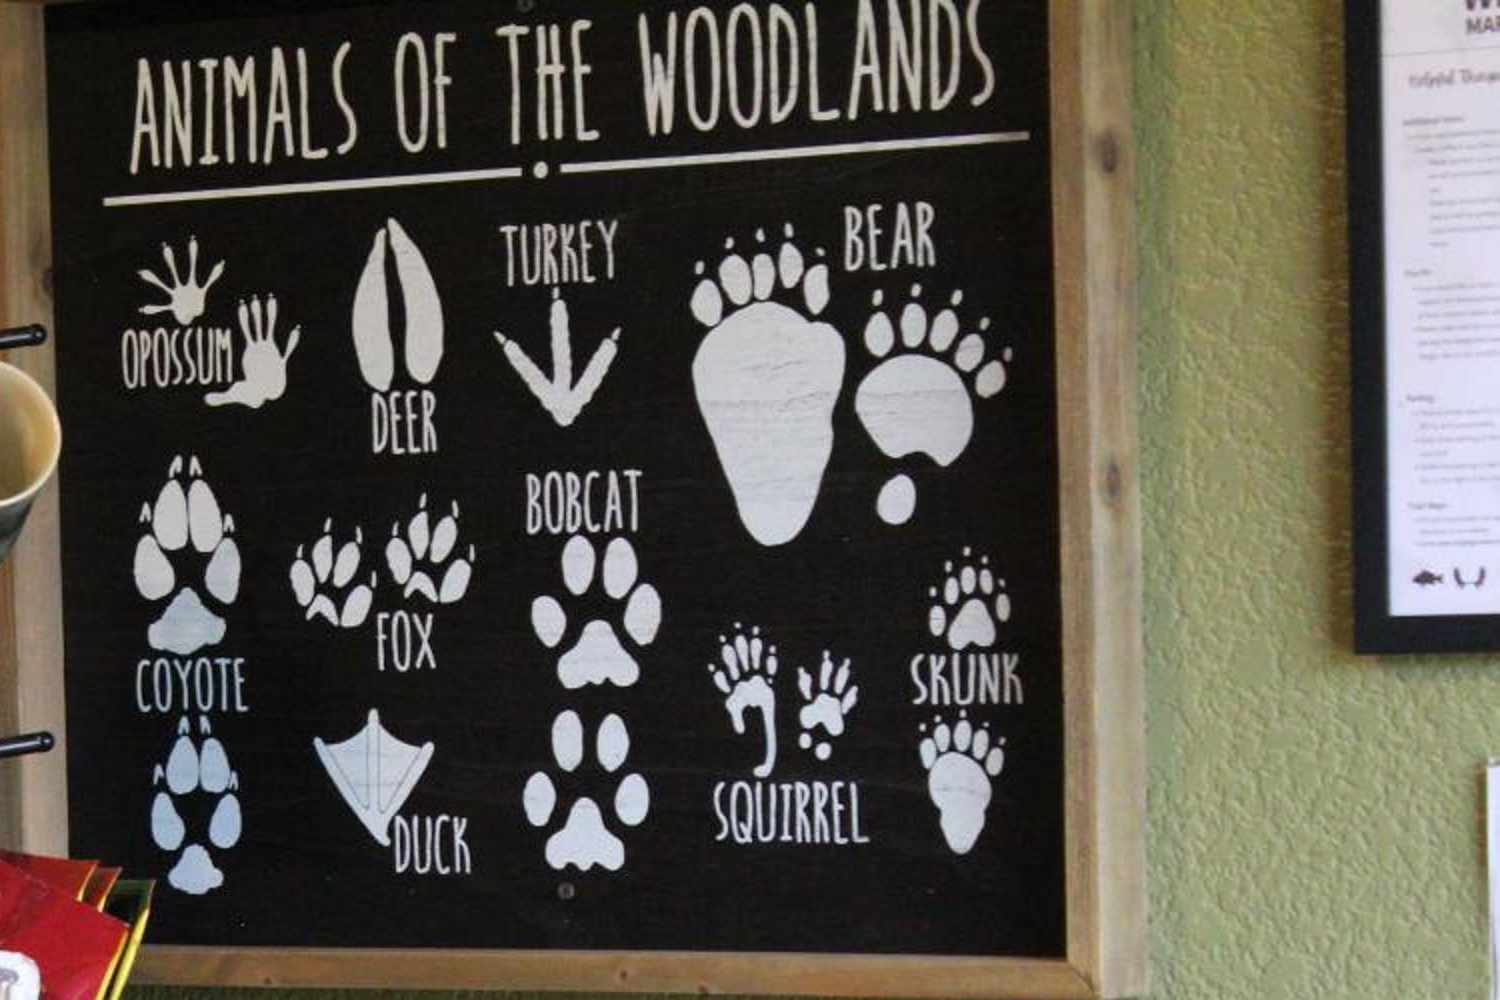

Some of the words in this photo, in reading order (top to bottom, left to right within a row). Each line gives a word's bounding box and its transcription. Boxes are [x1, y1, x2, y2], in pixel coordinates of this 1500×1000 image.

[129, 41, 357, 175] ANIMALS
[394, 31, 457, 153] OF
[496, 18, 600, 145] THE
[638, 0, 995, 137] WOODLANDS
[499, 219, 618, 287] TURKEY
[844, 201, 936, 272] BEAR
[121, 327, 233, 389] OPOSSUM
[371, 390, 438, 455] DEER
[526, 469, 643, 535] BOBCAT
[376, 609, 437, 673] FOX
[136, 657, 249, 713] COYOTE
[910, 652, 1023, 706] SKUNK
[394, 813, 472, 875] DUCK
[713, 780, 870, 845] SQUIRREL
